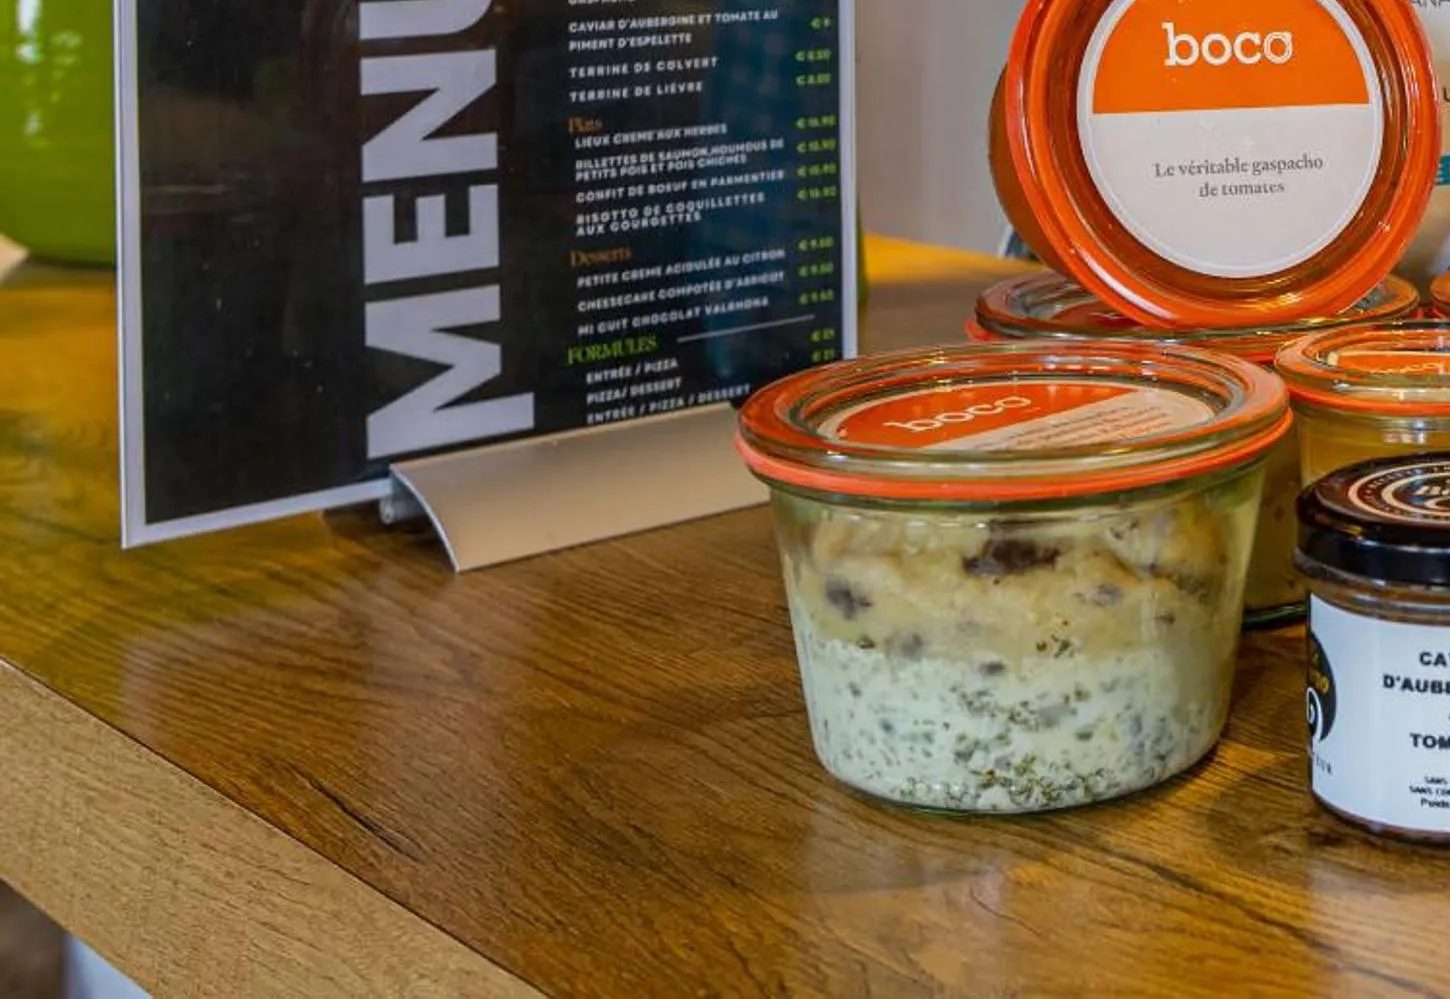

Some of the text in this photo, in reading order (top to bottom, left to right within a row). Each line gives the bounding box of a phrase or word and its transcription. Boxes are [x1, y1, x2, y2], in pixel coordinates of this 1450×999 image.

[569, 9, 779, 33] CAVIAR D'AUBERGINE ET TOMATE AU
[569, 33, 692, 51] PIMENT D'ESPELETTE
[1162, 22, 1293, 66] boco
[570, 56, 718, 78] TERRINE DE COLVERT
[569, 84, 651, 103] TERRINE DE
[1155, 153, 1323, 178] Le véritable gaspacho
[576, 188, 624, 204] CONFIT
[1199, 181, 1284, 197] de tomates
[665, 192, 765, 212] COQUILLETTES
[567, 336, 658, 365] FORMULES
